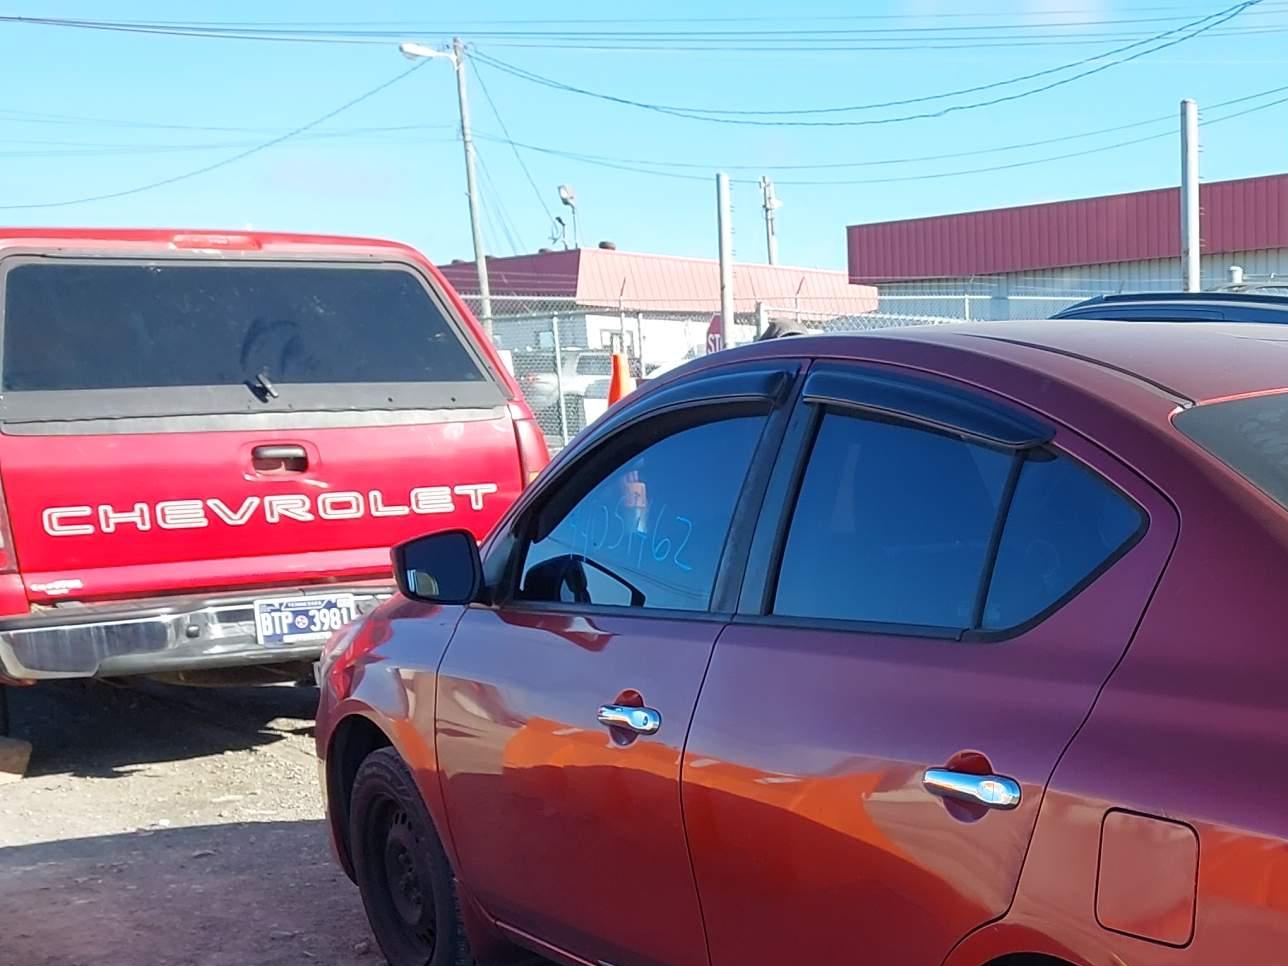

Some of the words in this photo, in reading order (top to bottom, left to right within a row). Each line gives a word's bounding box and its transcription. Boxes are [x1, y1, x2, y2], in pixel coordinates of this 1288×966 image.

[707, 334, 721, 353] ST
[42, 484, 498, 536] CHEVROLET
[260, 611, 294, 636] BTP
[308, 607, 349, 632] 3981
